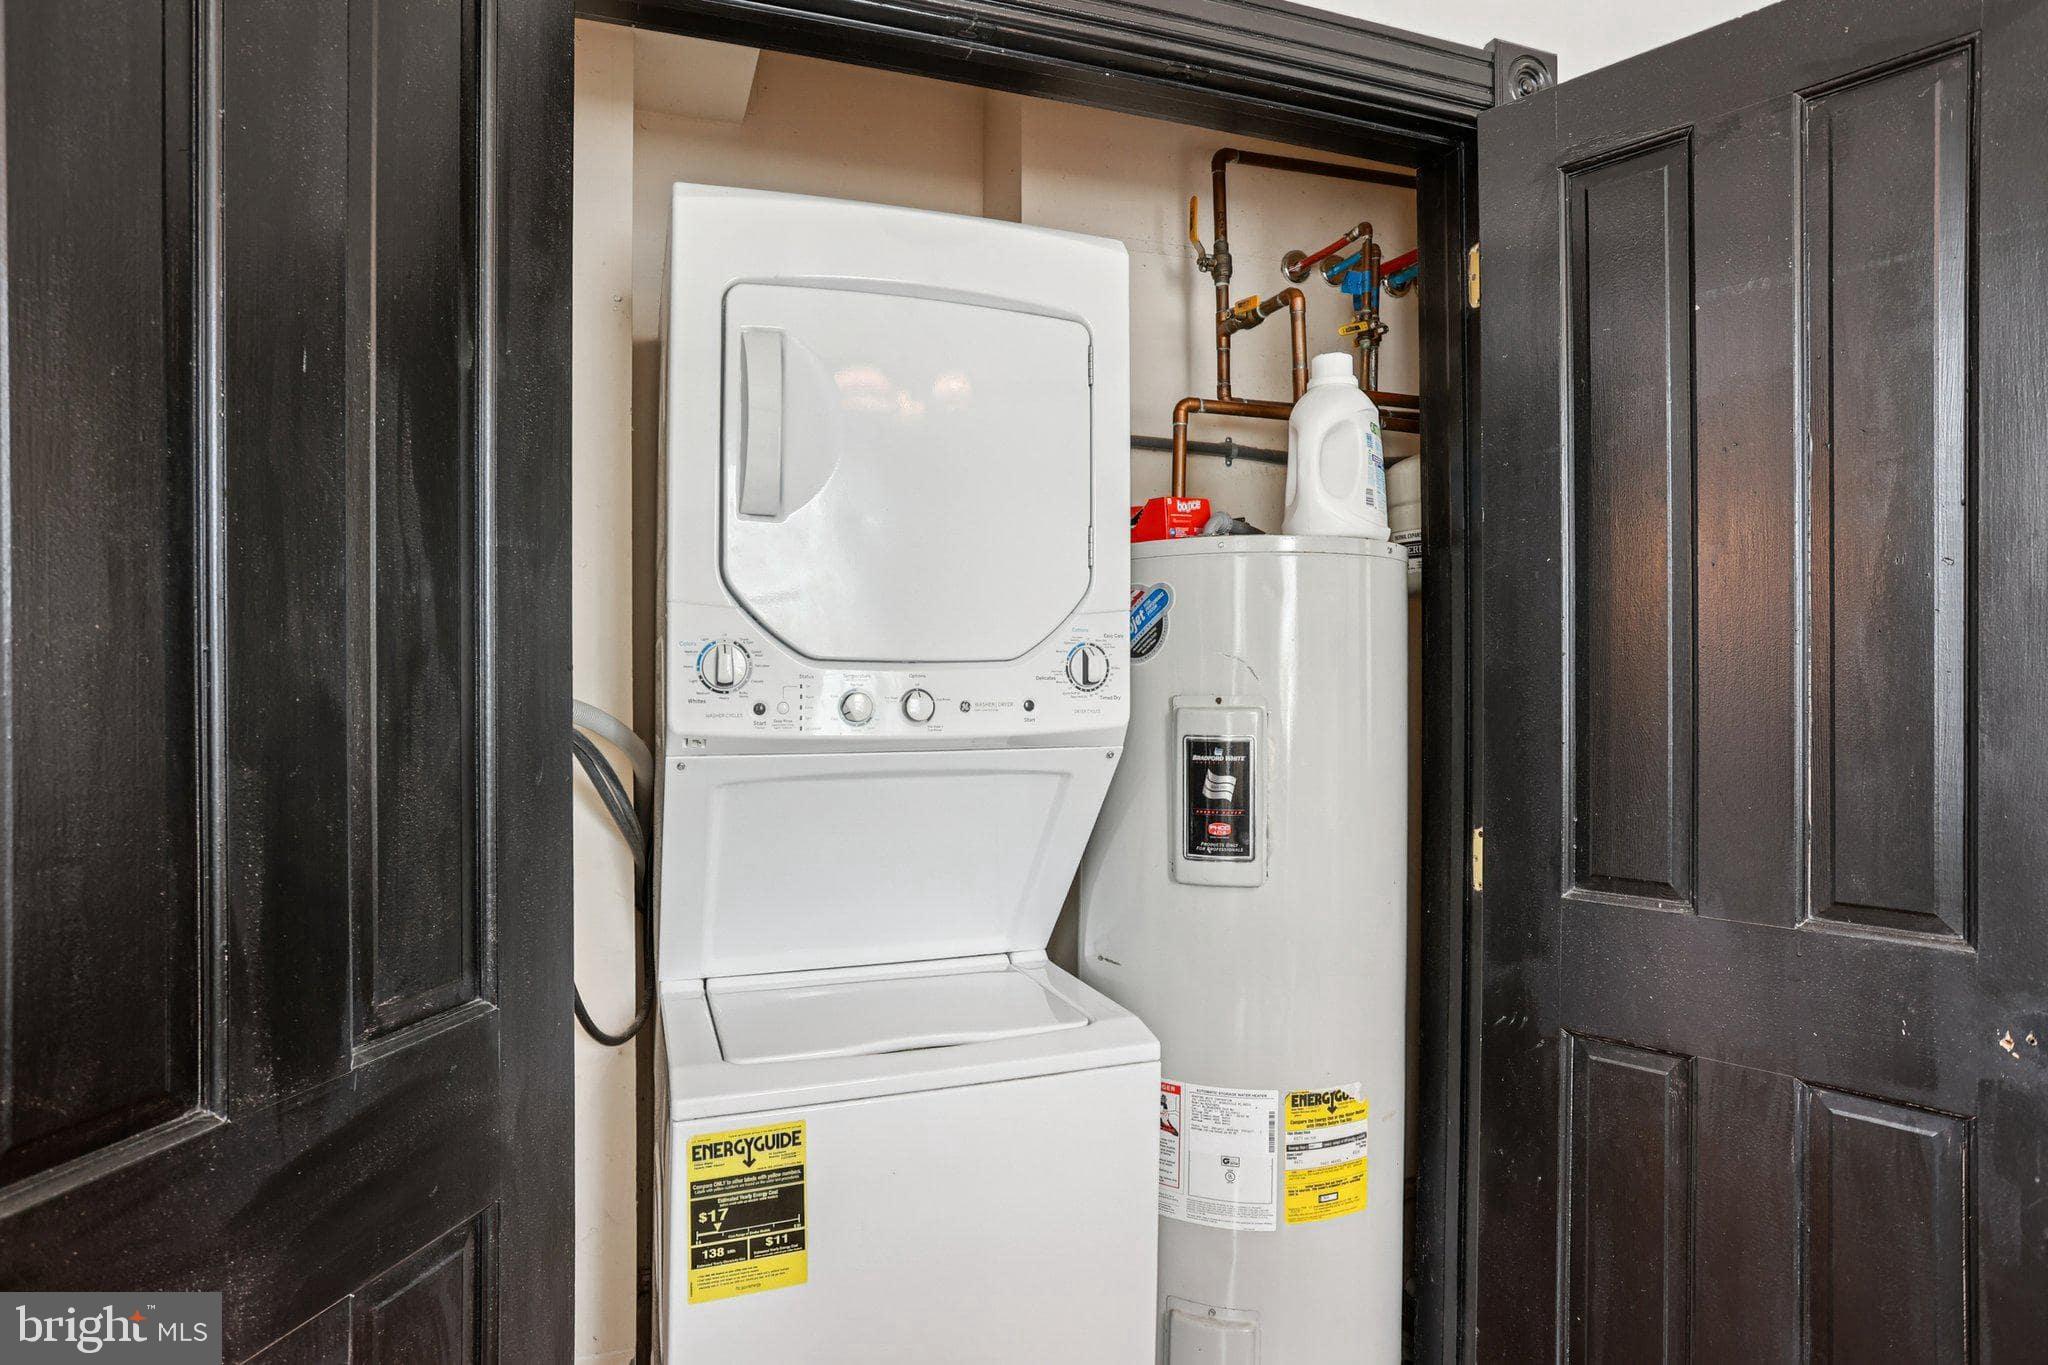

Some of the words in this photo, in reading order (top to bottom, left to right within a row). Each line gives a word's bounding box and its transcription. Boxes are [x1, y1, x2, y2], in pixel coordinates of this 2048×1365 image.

[692, 1130, 802, 1163] ENERGYGUIDE
[698, 1208, 729, 1224] $17
[765, 1234, 788, 1246] $11
[702, 1247, 724, 1259] 138
